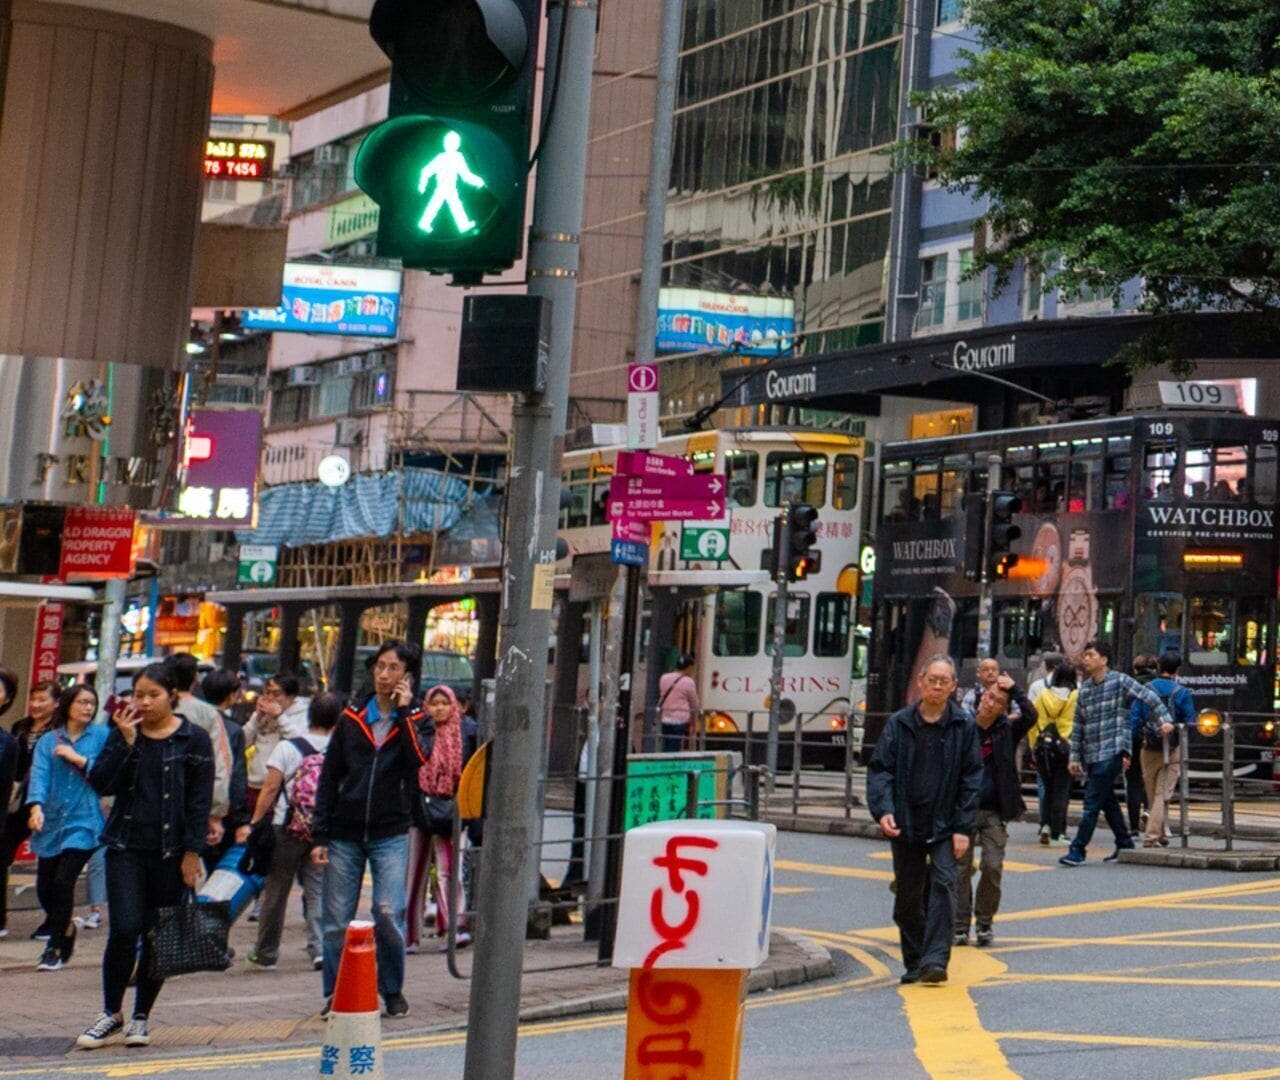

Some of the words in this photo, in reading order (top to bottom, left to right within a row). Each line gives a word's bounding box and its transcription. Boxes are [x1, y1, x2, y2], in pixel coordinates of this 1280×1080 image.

[952, 335, 1016, 371] Gourami
[766, 366, 817, 400] Gourami
[1176, 383, 1222, 405] 109
[1149, 423, 1174, 436] 109
[1262, 429, 1279, 442] 109
[1148, 506, 1275, 528] WATCHBOX
[82, 527, 132, 538] DRAGON
[1147, 530, 1193, 538] CERTIFIED
[1195, 531, 1241, 539] PRE-OWNED
[64, 540, 116, 551] ROPERTY
[893, 538, 957, 559] WATCHBOX
[64, 553, 111, 565] AGENCY
[722, 675, 841, 694] CLARINS
[319, 1045, 376, 1075] 警察
